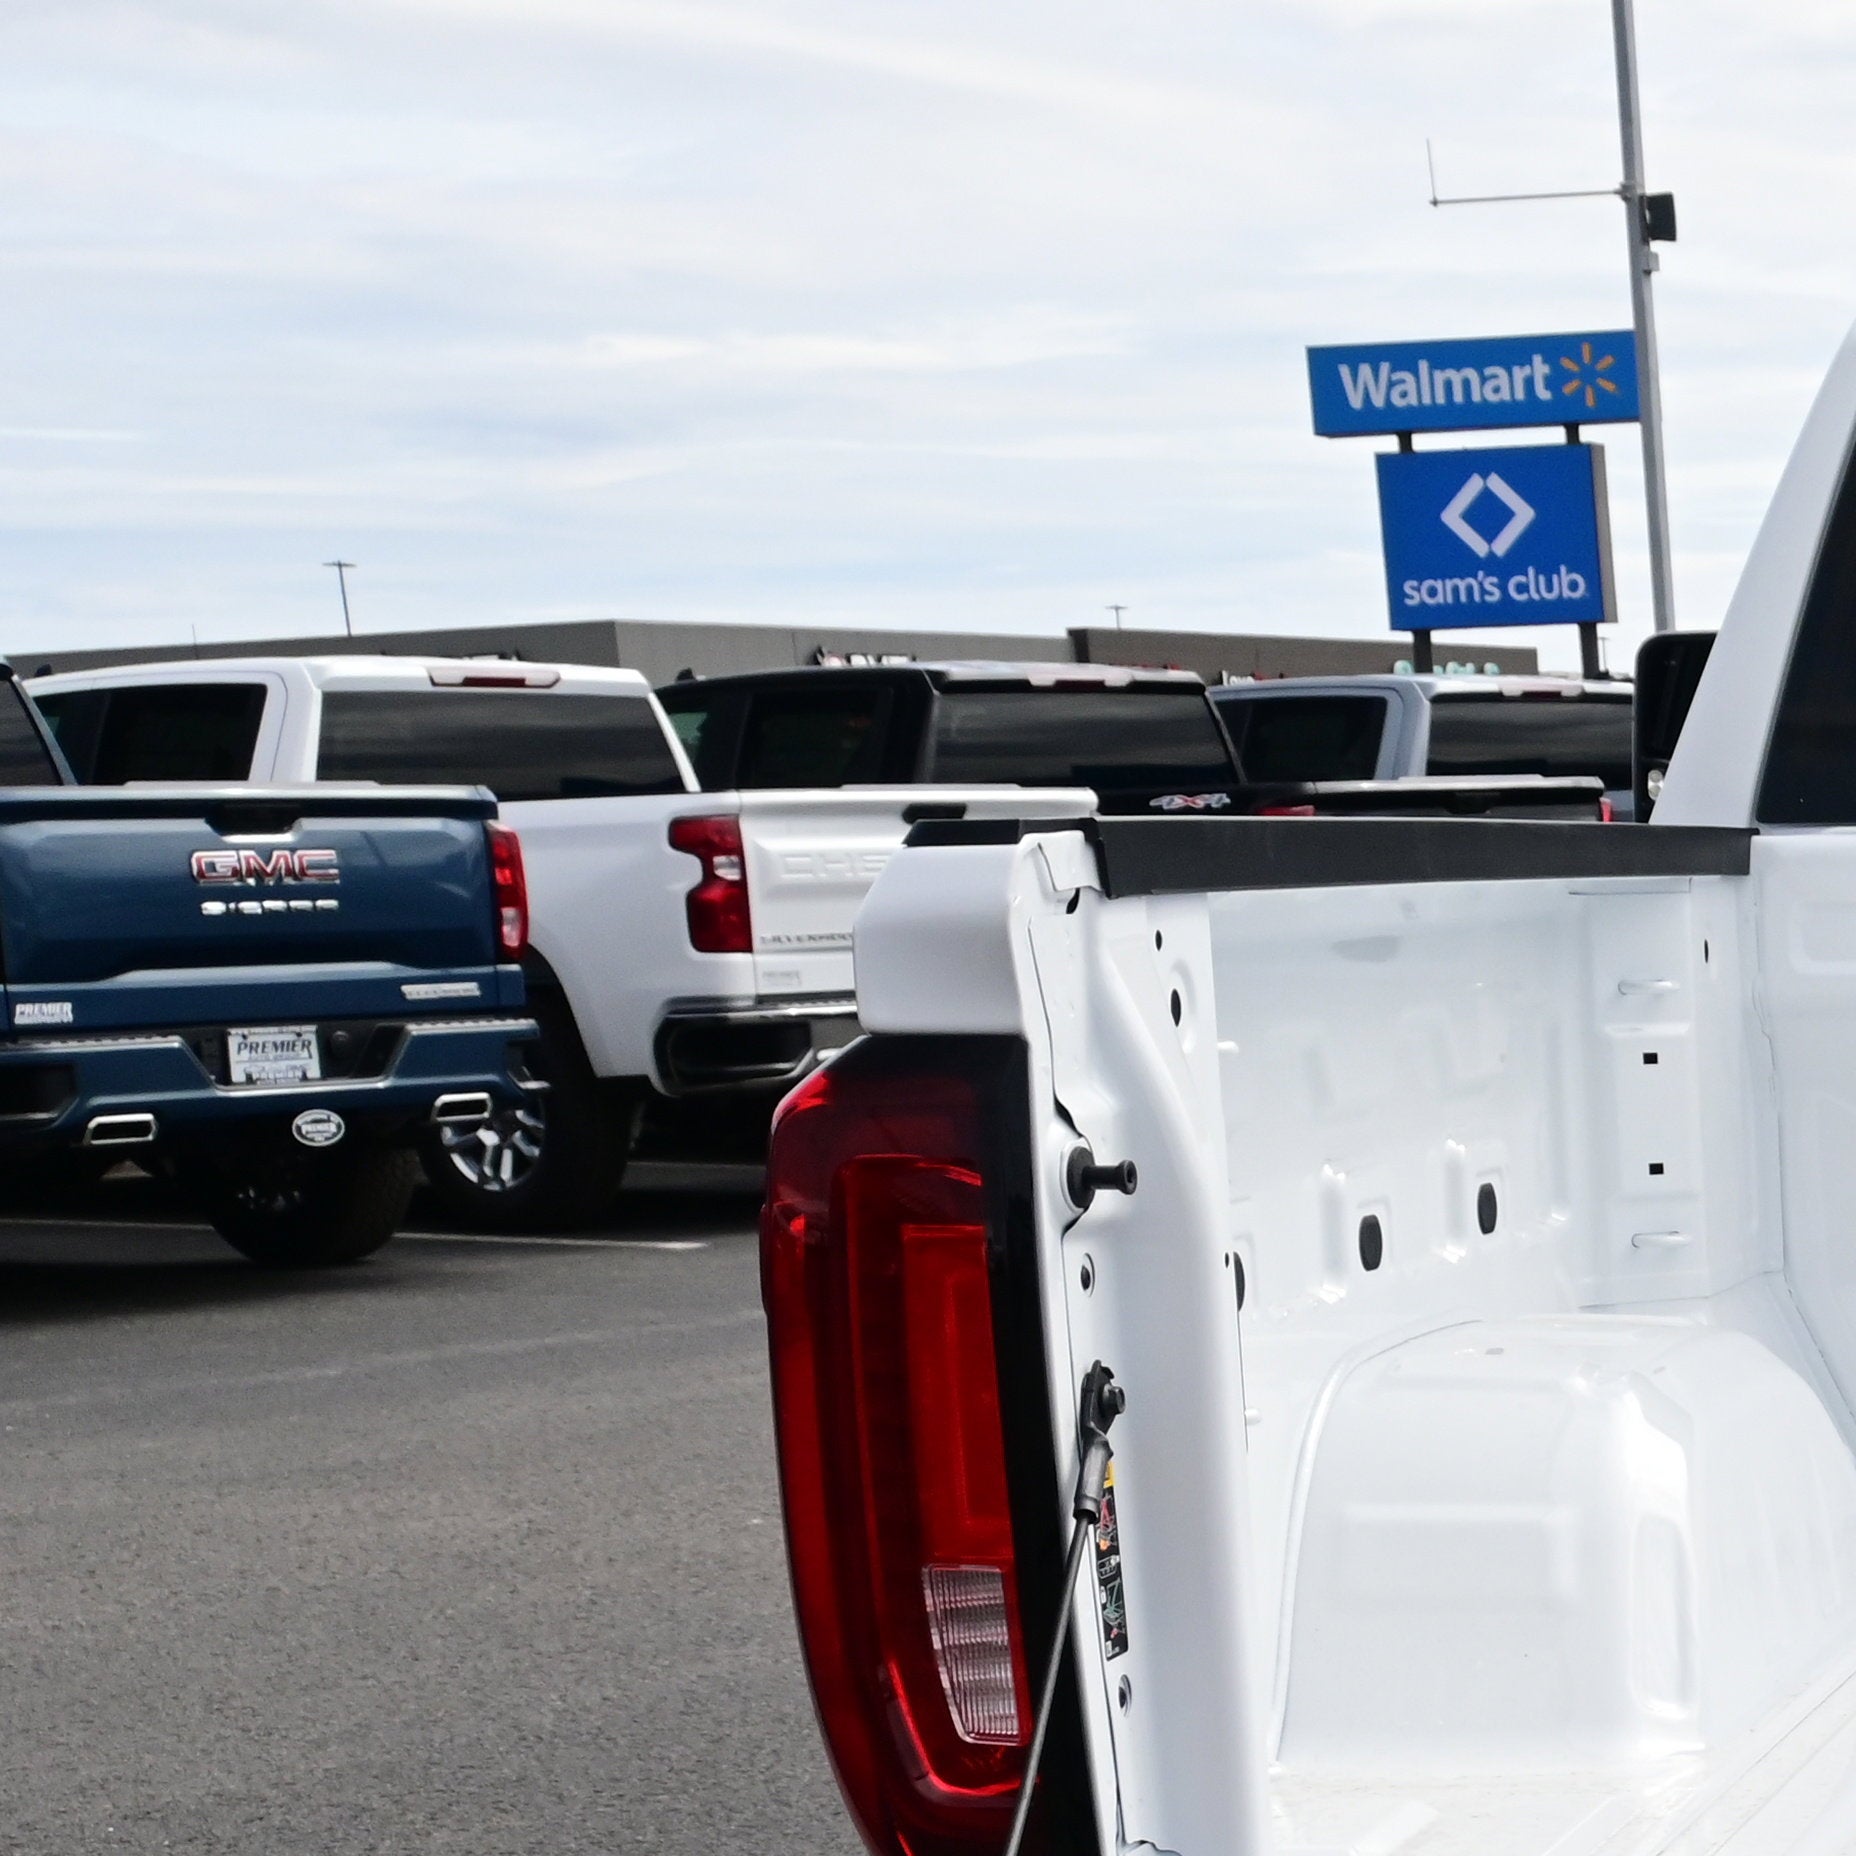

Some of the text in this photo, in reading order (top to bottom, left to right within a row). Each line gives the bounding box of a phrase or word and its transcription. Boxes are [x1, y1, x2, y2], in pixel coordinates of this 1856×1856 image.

[1338, 353, 1553, 411] Walmart
[1403, 564, 1586, 606] sam's club
[191, 849, 340, 886] GMC
[236, 1039, 313, 1060] PREMIER
